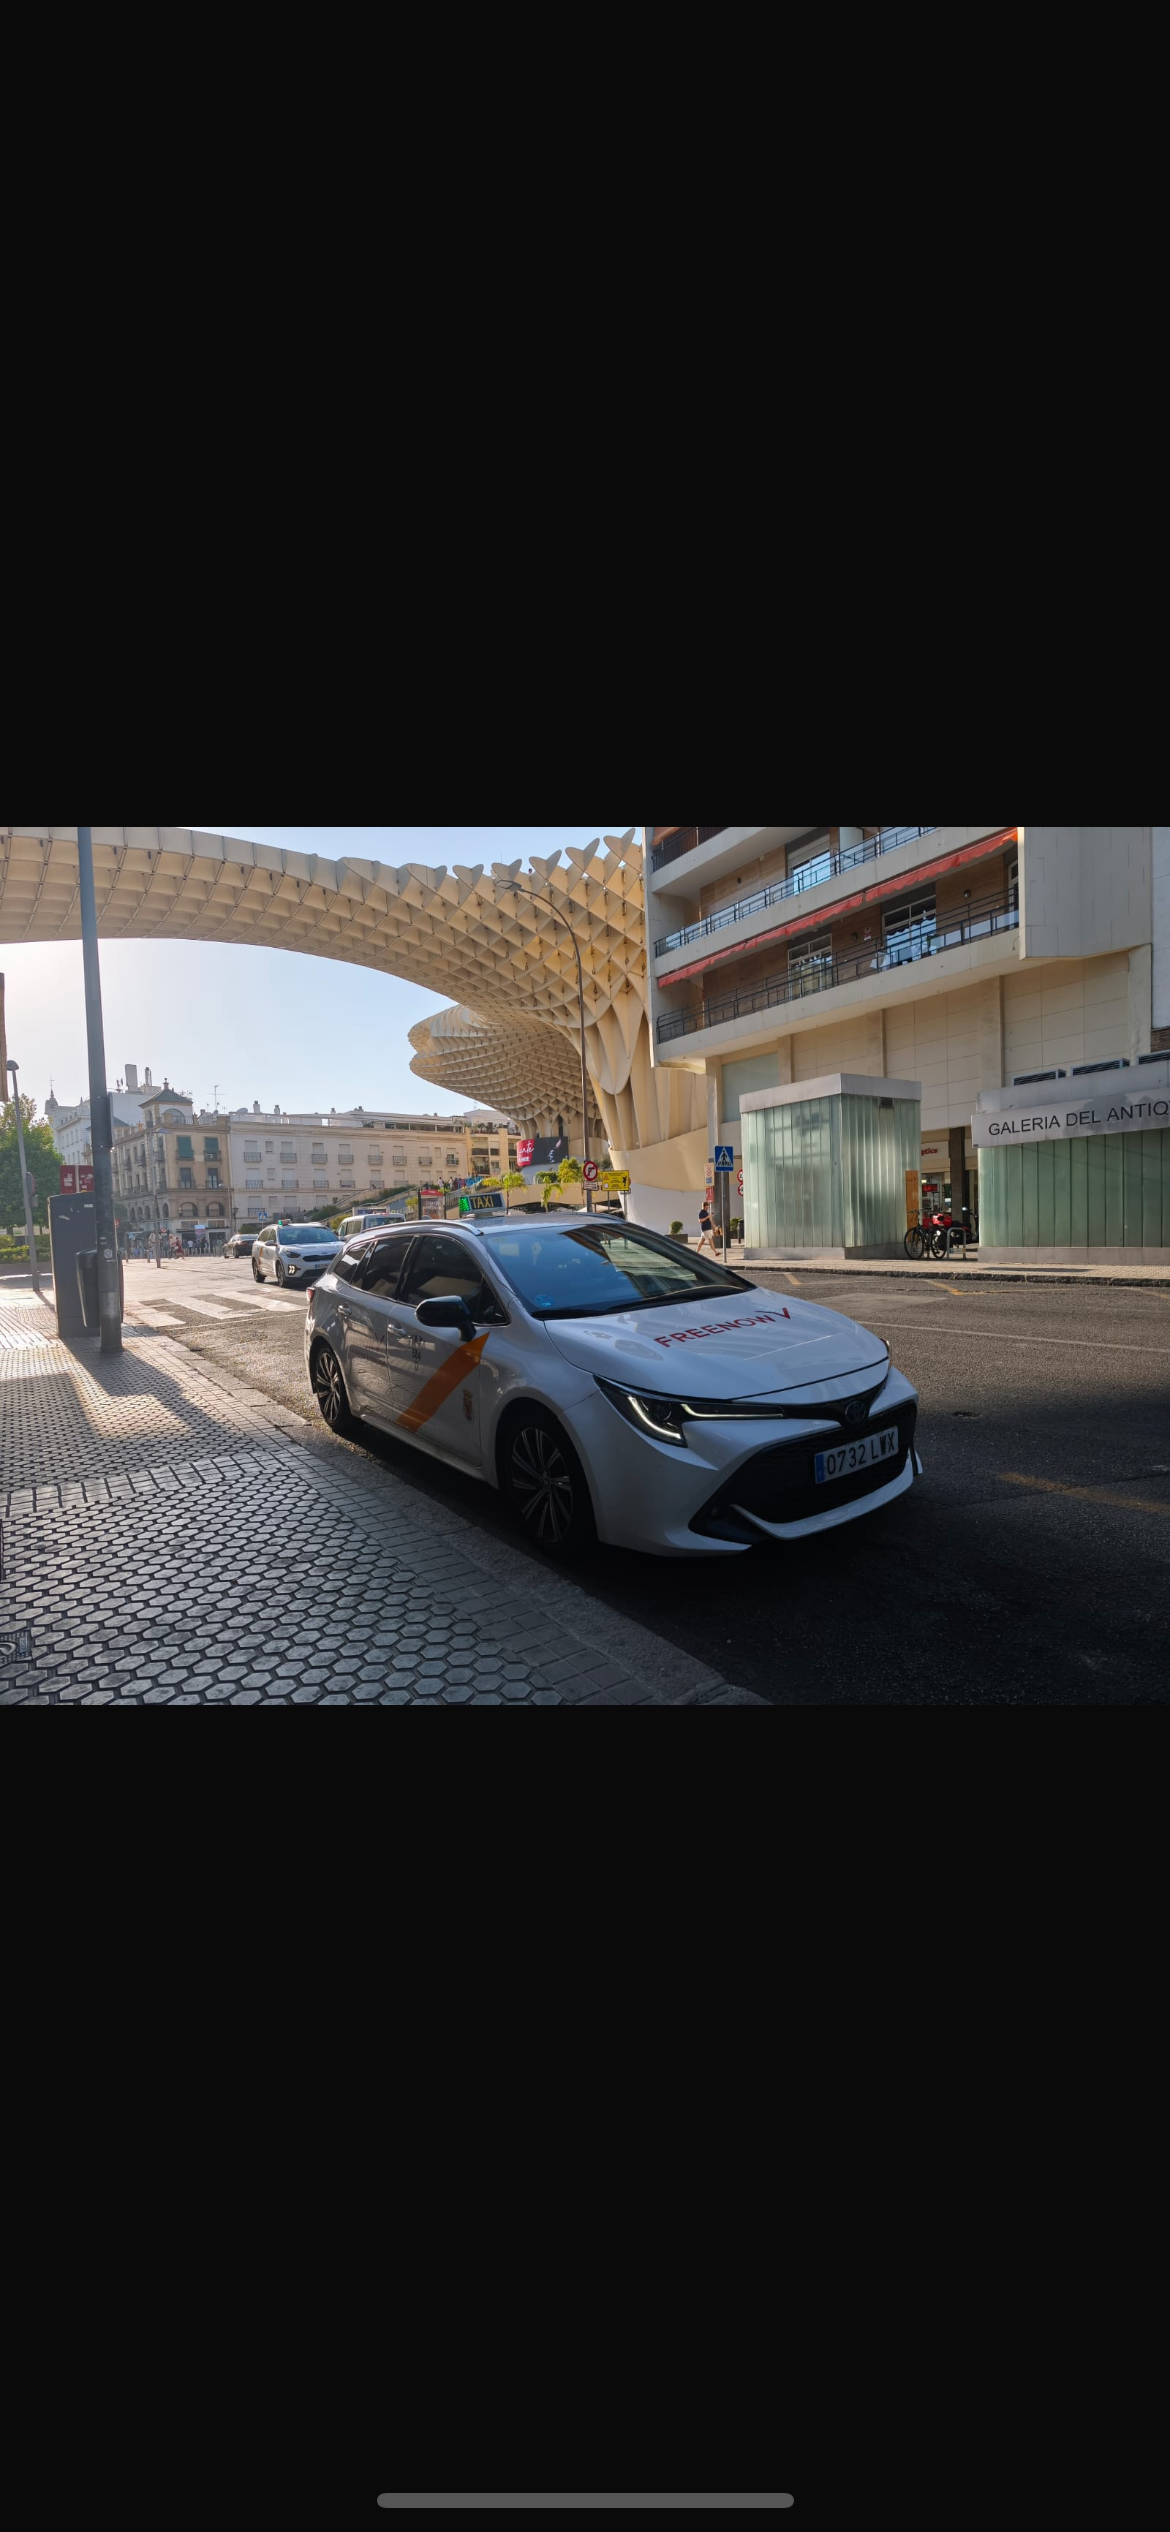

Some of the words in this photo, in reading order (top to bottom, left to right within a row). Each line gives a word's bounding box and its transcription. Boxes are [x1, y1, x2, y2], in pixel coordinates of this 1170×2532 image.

[989, 1115, 1061, 1136] GALERIA
[1066, 1110, 1101, 1127] DEL
[1107, 1100, 1170, 1122] ANTIQ
[921, 1147, 938, 1156] ptica
[470, 1195, 494, 1209] TAXI
[826, 1443, 866, 1475] 0732
[871, 1431, 895, 1460] LWX
